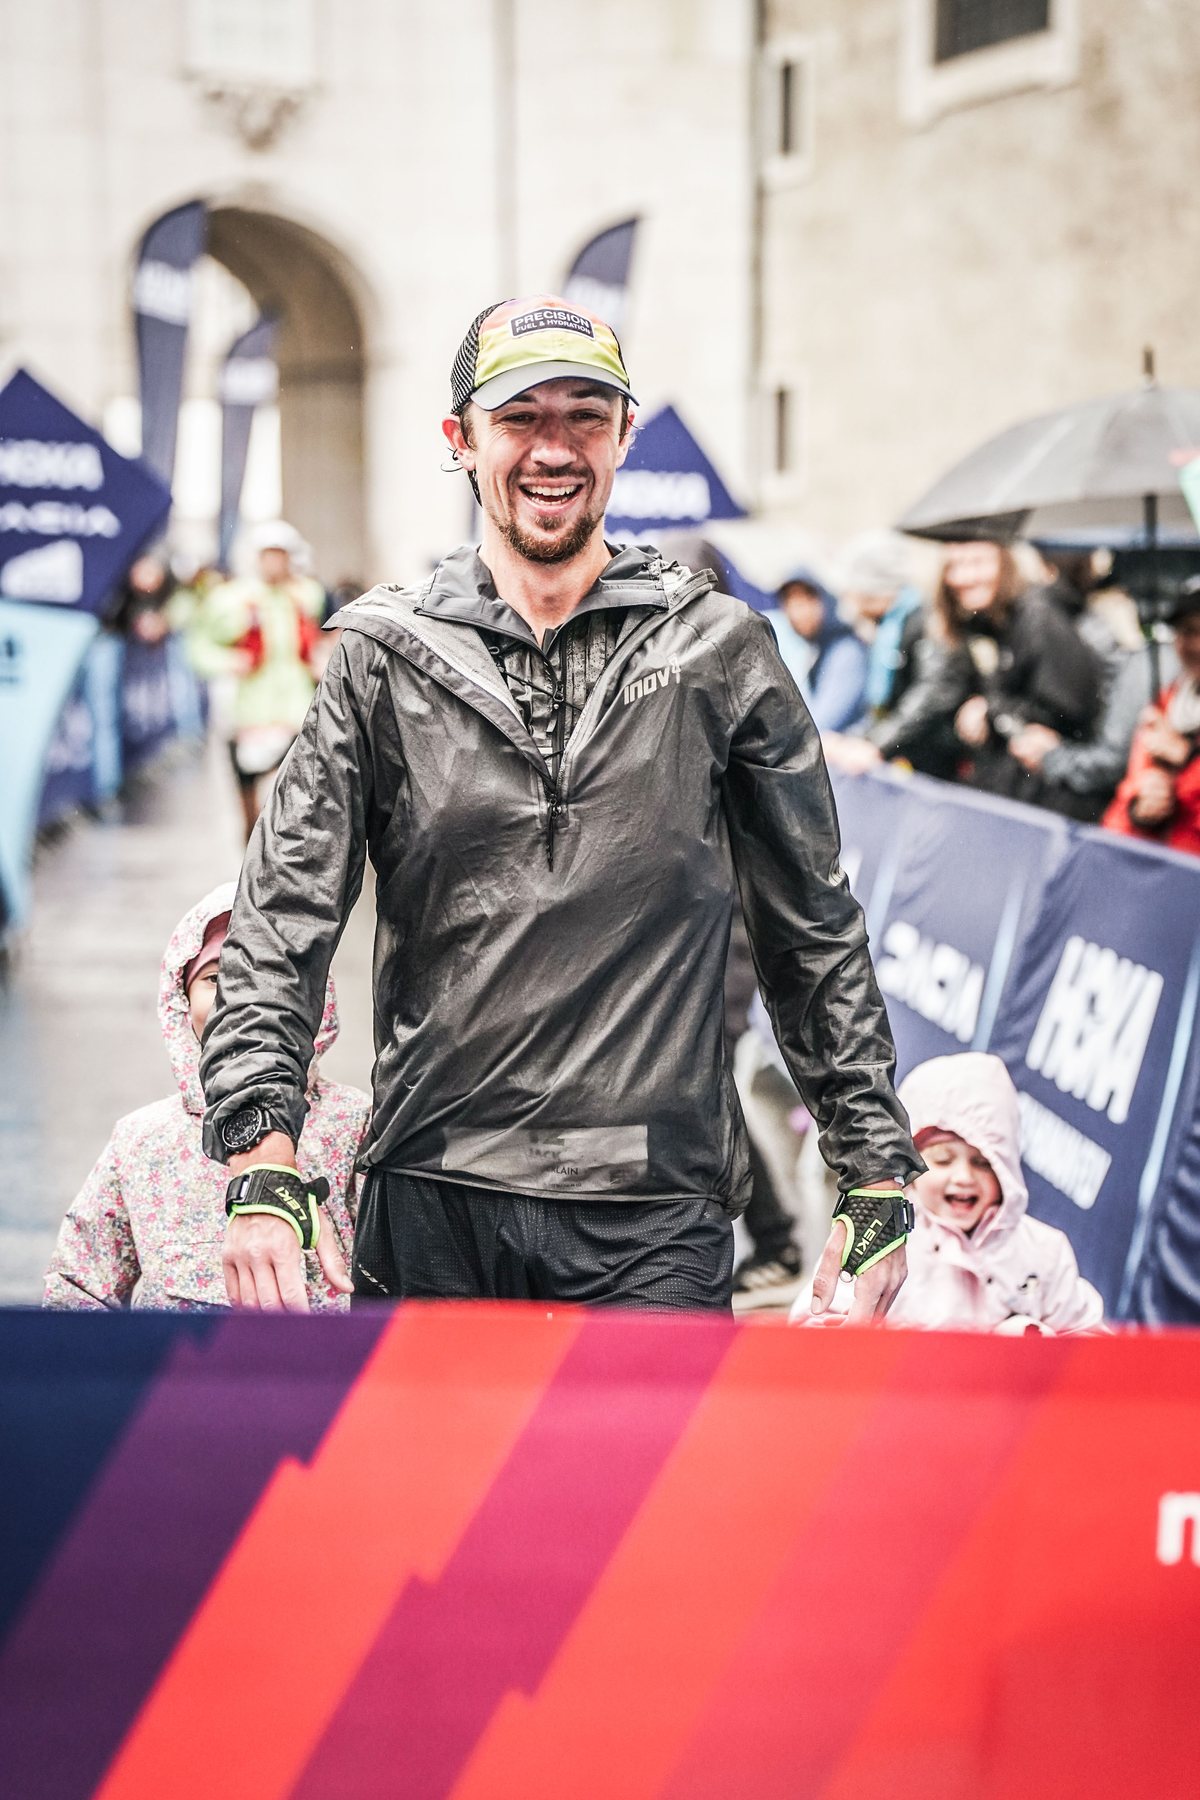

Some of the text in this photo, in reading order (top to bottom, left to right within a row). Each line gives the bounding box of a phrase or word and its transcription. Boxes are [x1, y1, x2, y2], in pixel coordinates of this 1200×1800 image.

[515, 310, 590, 328] PRECISION
[516, 322, 537, 333] FUEL
[547, 319, 591, 334] HYDRATION
[275, 1186, 307, 1220] LEKI
[854, 1218, 882, 1256] LEKI
